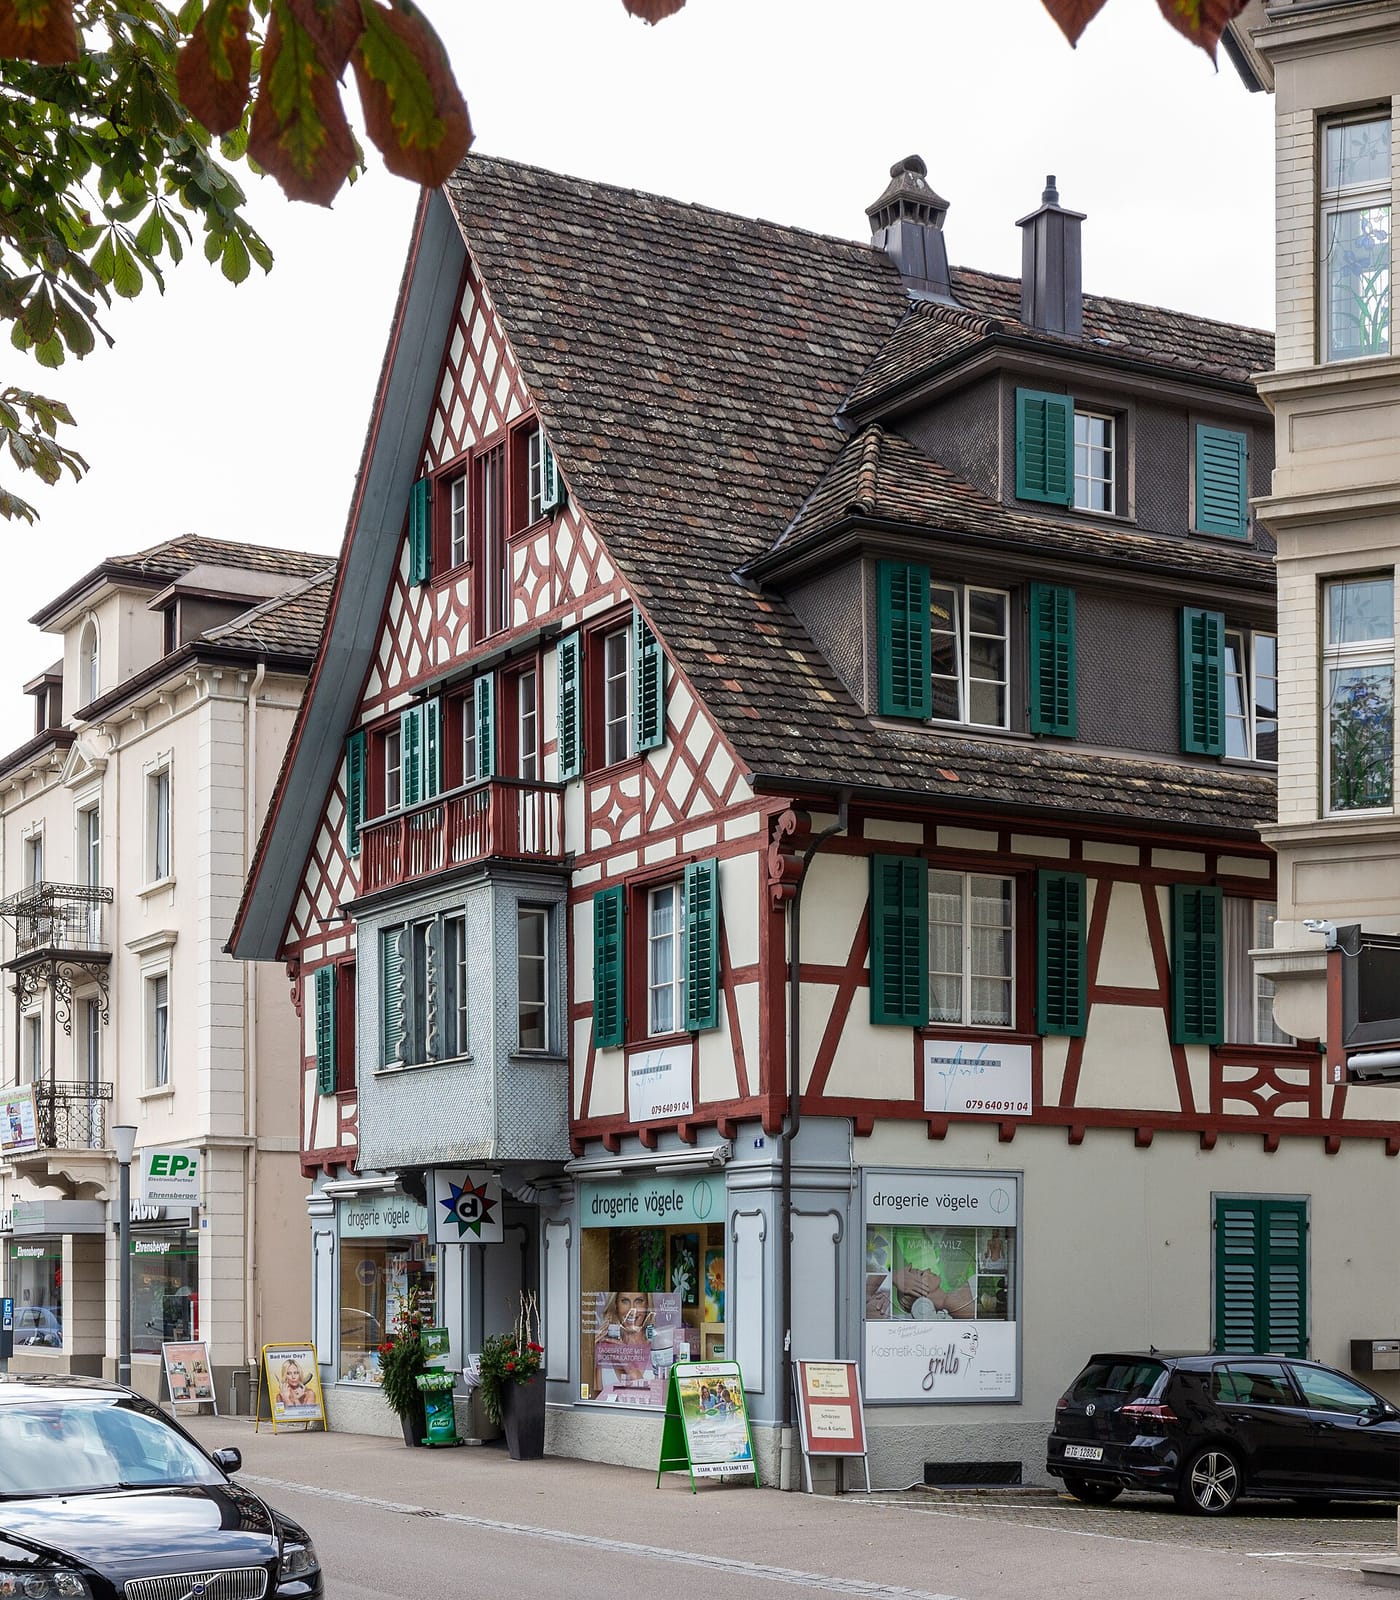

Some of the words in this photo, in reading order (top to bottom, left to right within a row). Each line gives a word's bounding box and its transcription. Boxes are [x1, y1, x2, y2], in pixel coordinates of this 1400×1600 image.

[652, 1105, 661, 1114] 079
[662, 1103, 673, 1113] 640
[674, 1102, 680, 1111] 91
[682, 1101, 689, 1110] 04
[966, 1100, 983, 1109] 079
[985, 1100, 1002, 1110] 640
[1004, 1102, 1014, 1110] 91
[1017, 1102, 1028, 1111] 04
[150, 1154, 197, 1176] EP:
[148, 1192, 197, 1200] Ehrensberger
[592, 1192, 639, 1218] drogerie
[644, 1189, 684, 1216] vögele
[872, 1192, 929, 1210] drogerie
[936, 1194, 979, 1211] vögele
[460, 1198, 478, 1218] d
[348, 1208, 380, 1230] drogerie
[383, 1206, 410, 1228] vögele
[940, 1240, 962, 1250] WILZ
[872, 1344, 944, 1357] Kosmetik-Studio
[922, 1344, 960, 1391] grillo
